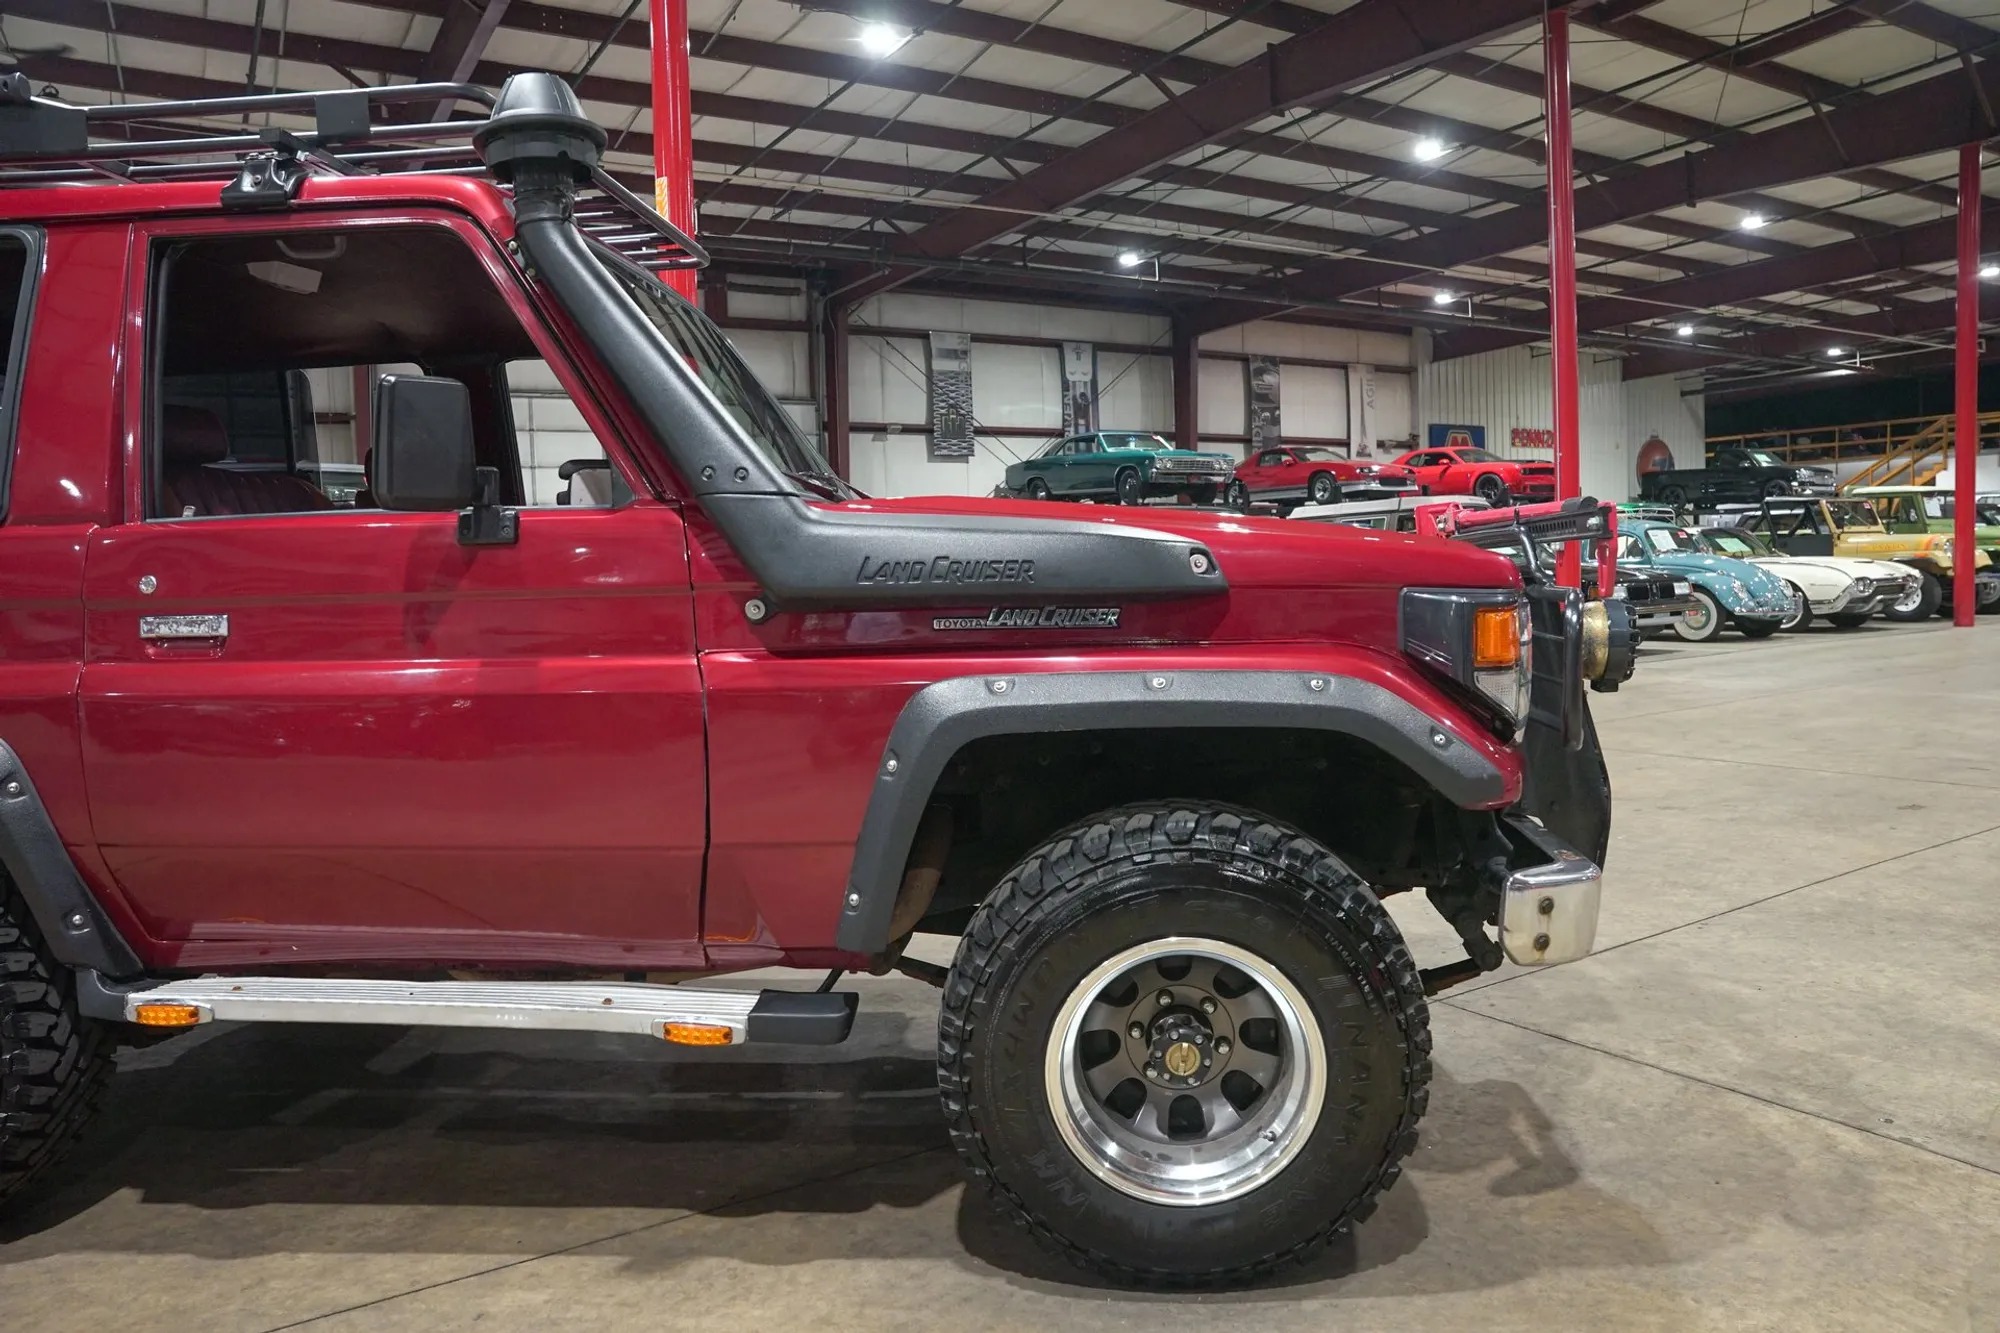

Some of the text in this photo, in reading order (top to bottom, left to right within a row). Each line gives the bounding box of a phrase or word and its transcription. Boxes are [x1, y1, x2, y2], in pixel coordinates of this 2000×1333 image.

[857, 556, 1036, 584] LAND CRUISER
[936, 605, 1121, 628] TOYOTA LAND CRUISER
